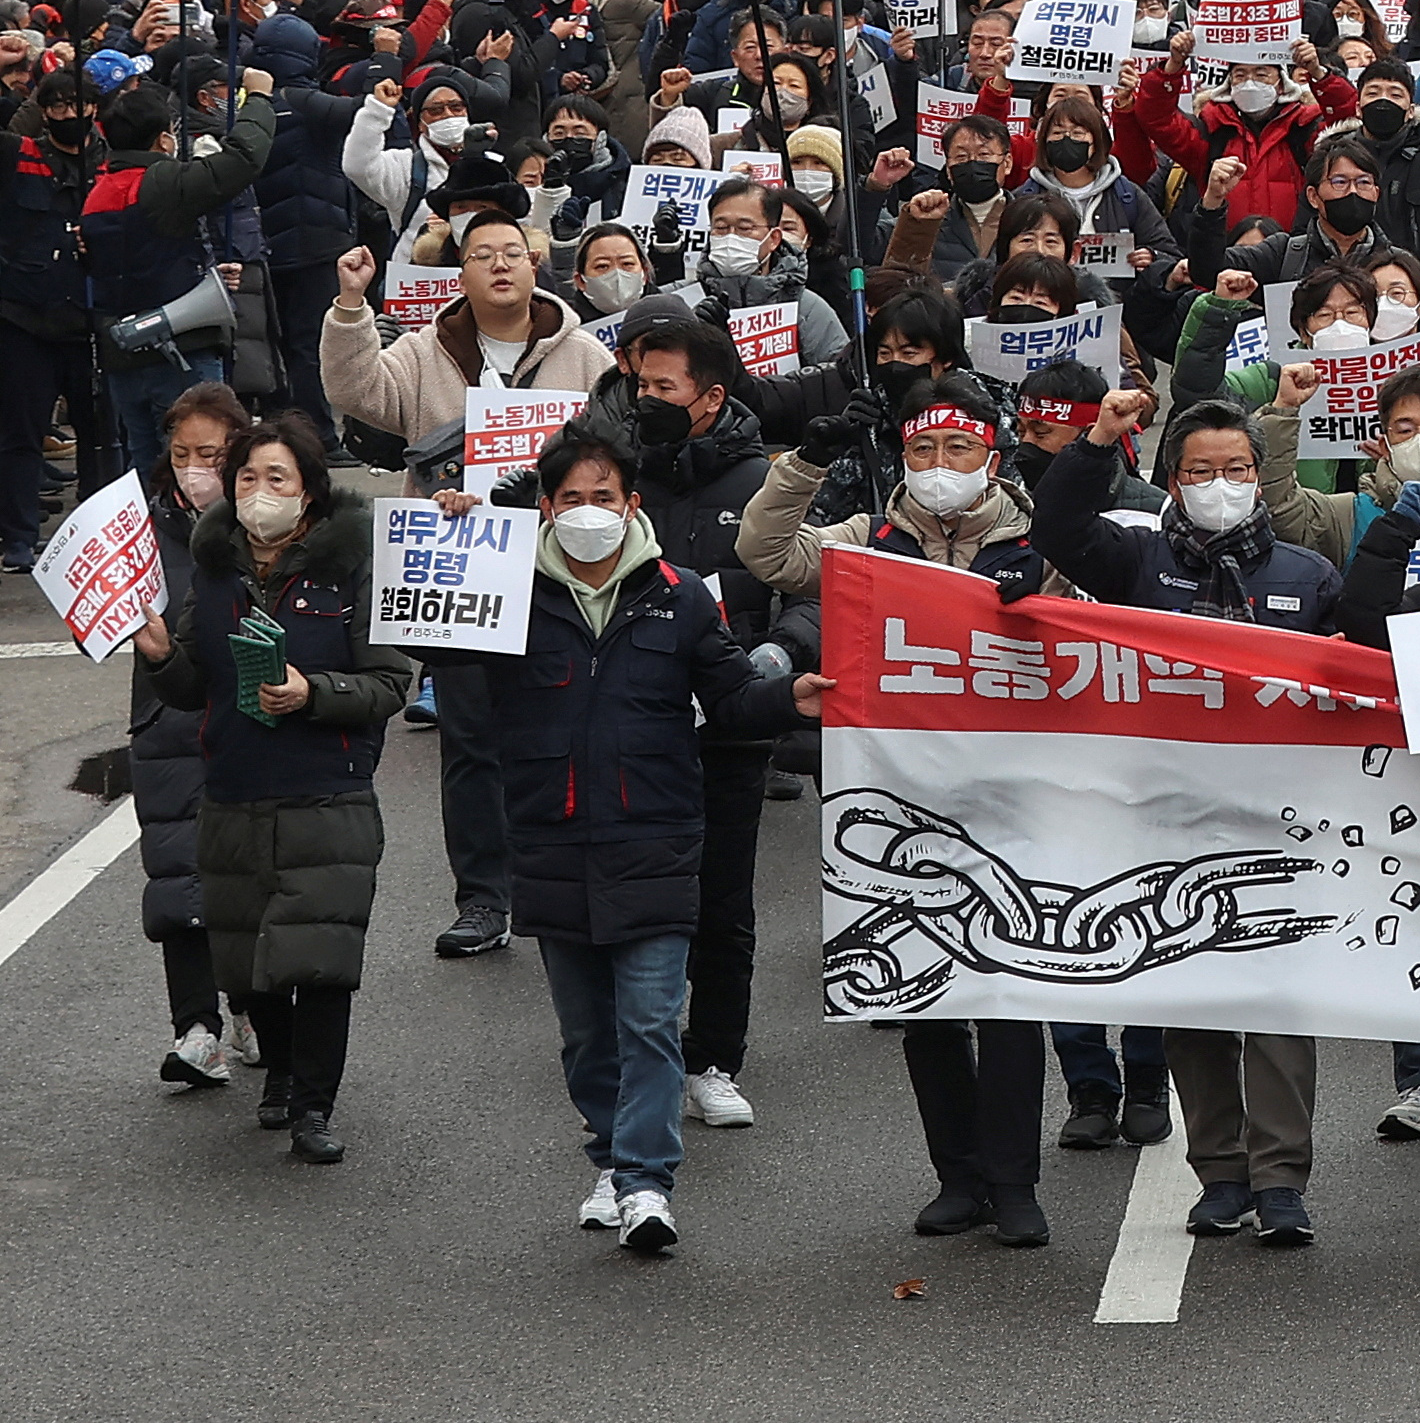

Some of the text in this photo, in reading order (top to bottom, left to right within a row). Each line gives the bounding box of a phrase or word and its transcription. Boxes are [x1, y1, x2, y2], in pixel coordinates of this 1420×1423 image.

[1034, 2, 1119, 27] 업무개시
[1049, 25, 1093, 47] 명령
[1206, 24, 1289, 44] 민영화 중단!
[1021, 45, 1113, 73] 철회하라!
[1001, 315, 1103, 355] 업무개시
[1037, 399, 1072, 420] 투쟁
[474, 434, 530, 460] 노조법
[388, 509, 512, 552] 업무개시
[403, 550, 468, 586] 명령
[379, 587, 504, 630] 철회하라!
